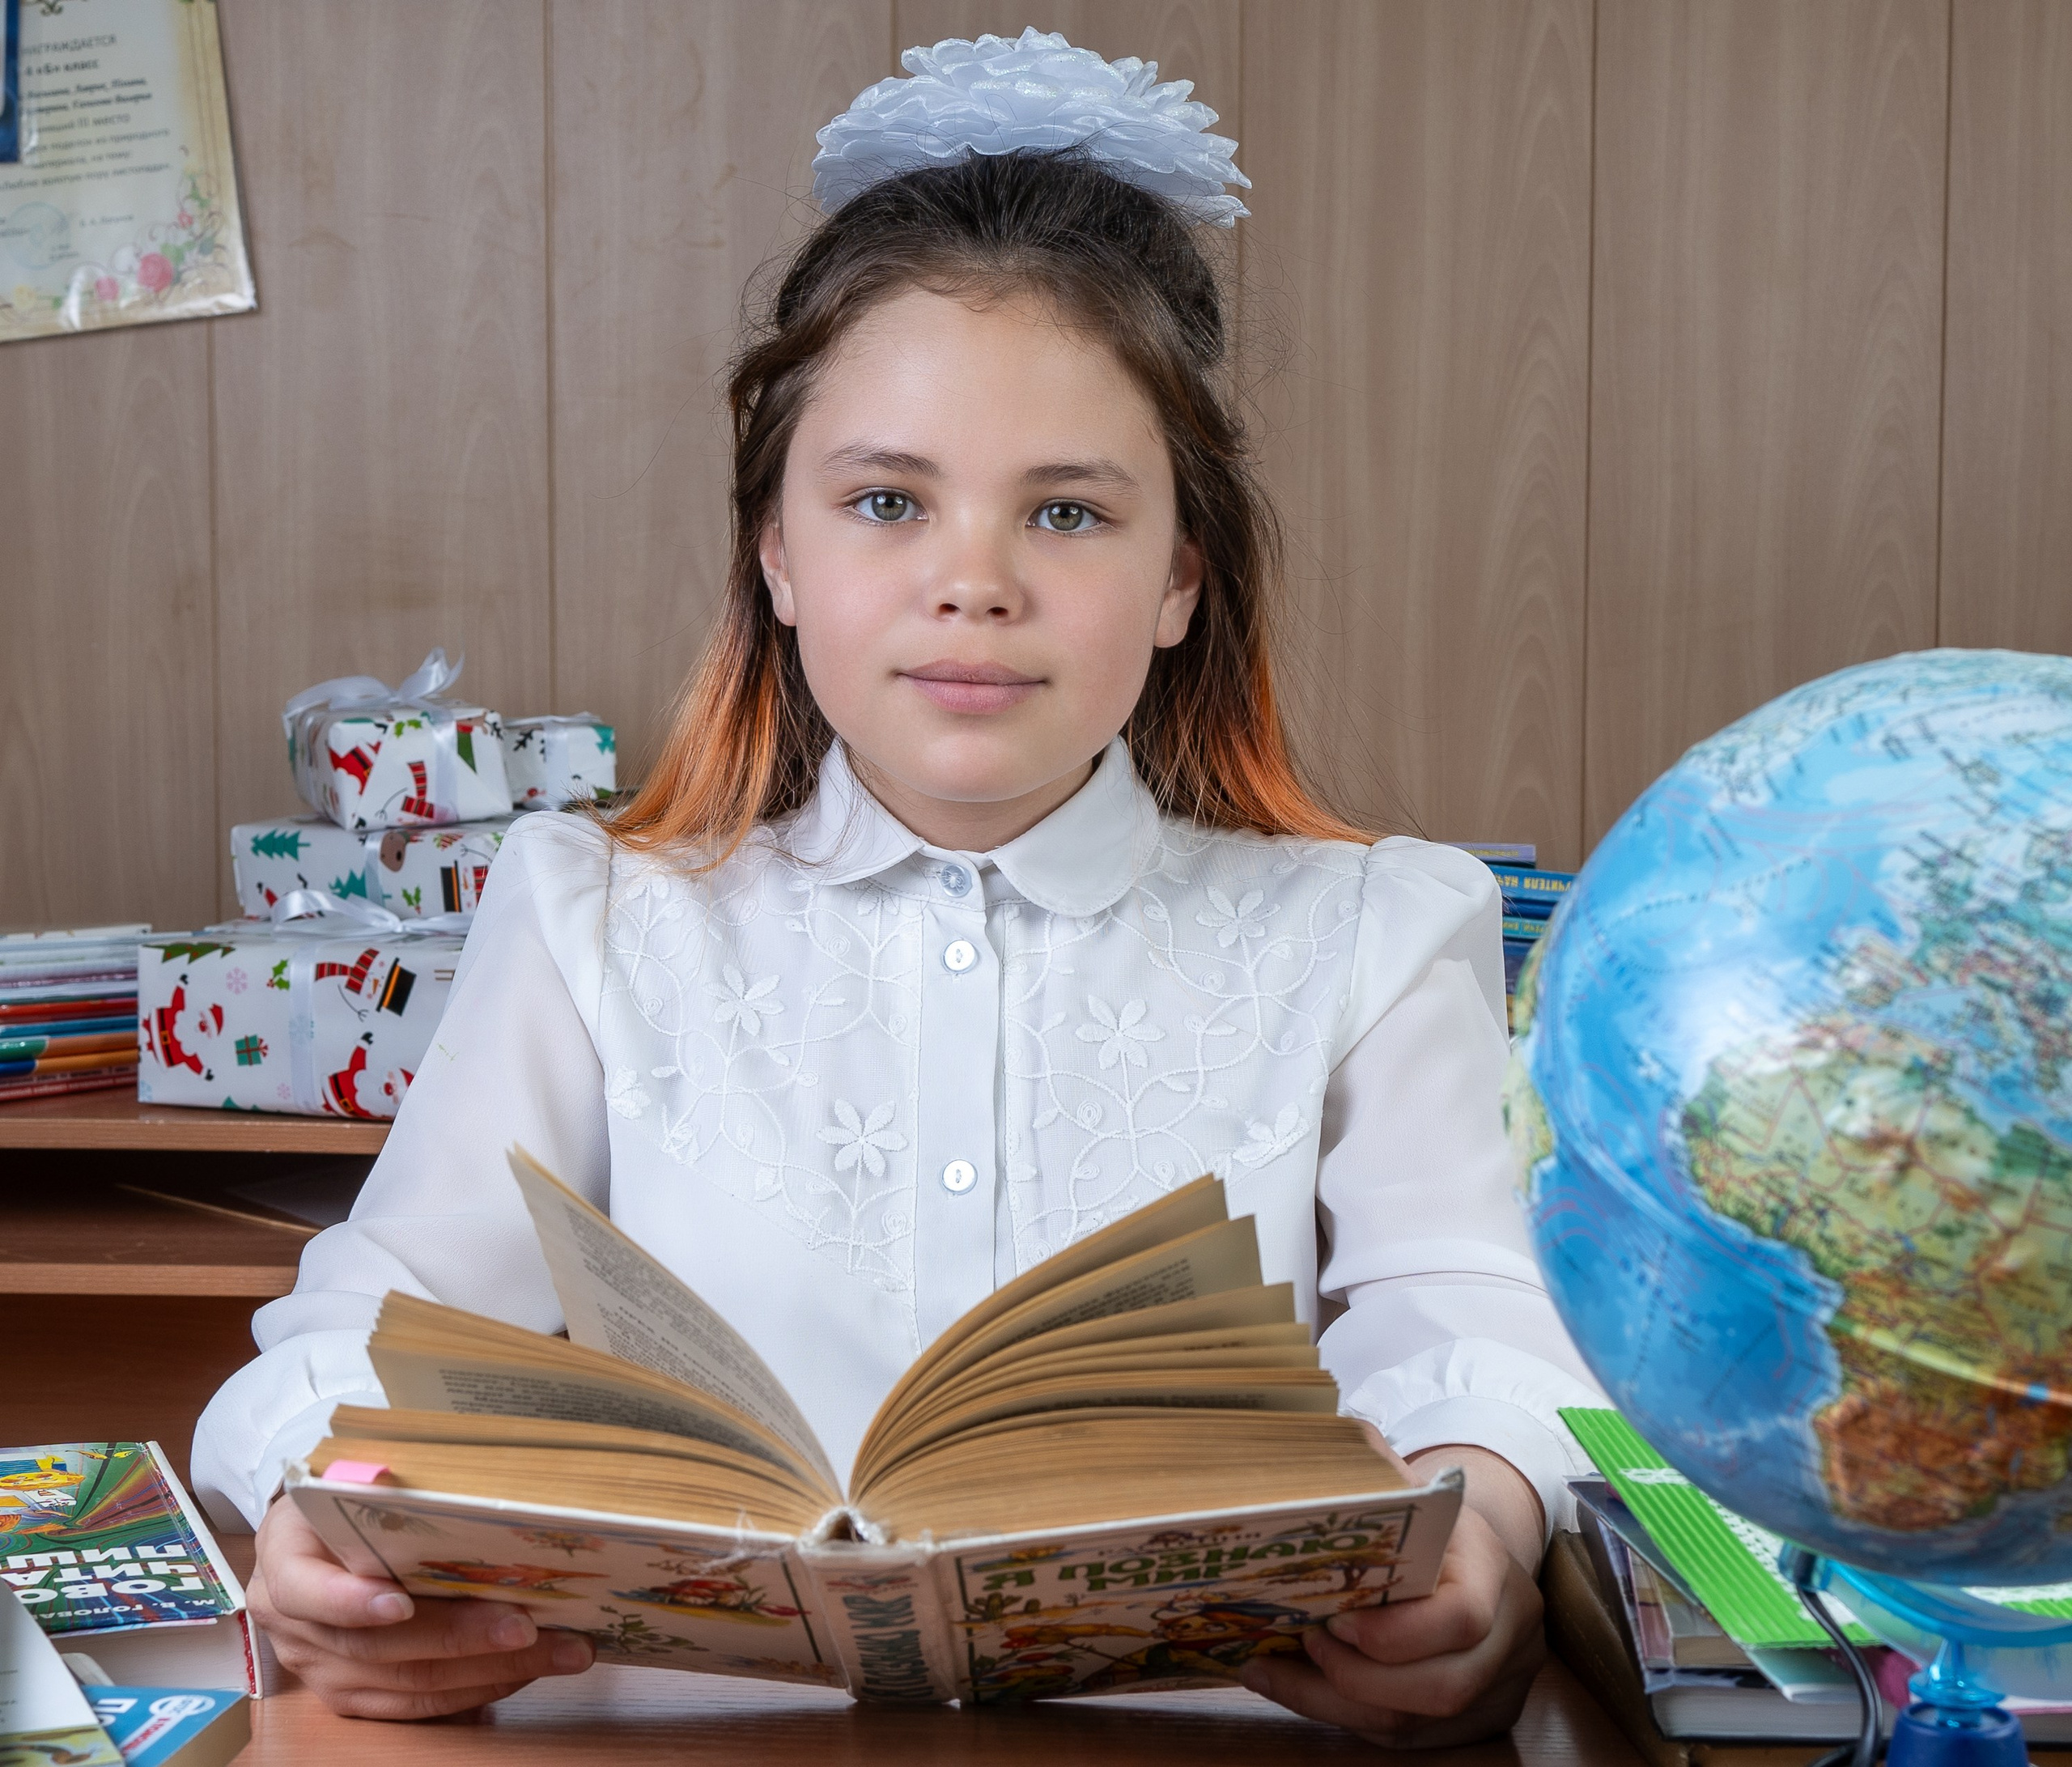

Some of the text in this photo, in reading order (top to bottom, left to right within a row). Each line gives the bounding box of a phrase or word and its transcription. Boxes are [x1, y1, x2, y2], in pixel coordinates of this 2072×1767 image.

[0, 1544, 188, 1569] ПИШ
[982, 1570, 1035, 1591] Я
[1059, 1535, 1369, 1580] ПОЗНАЮ
[1088, 1561, 1248, 1591] МИР
[35, 1603, 143, 1620] ГОЛОВА
[185, 1598, 215, 1606] М.
